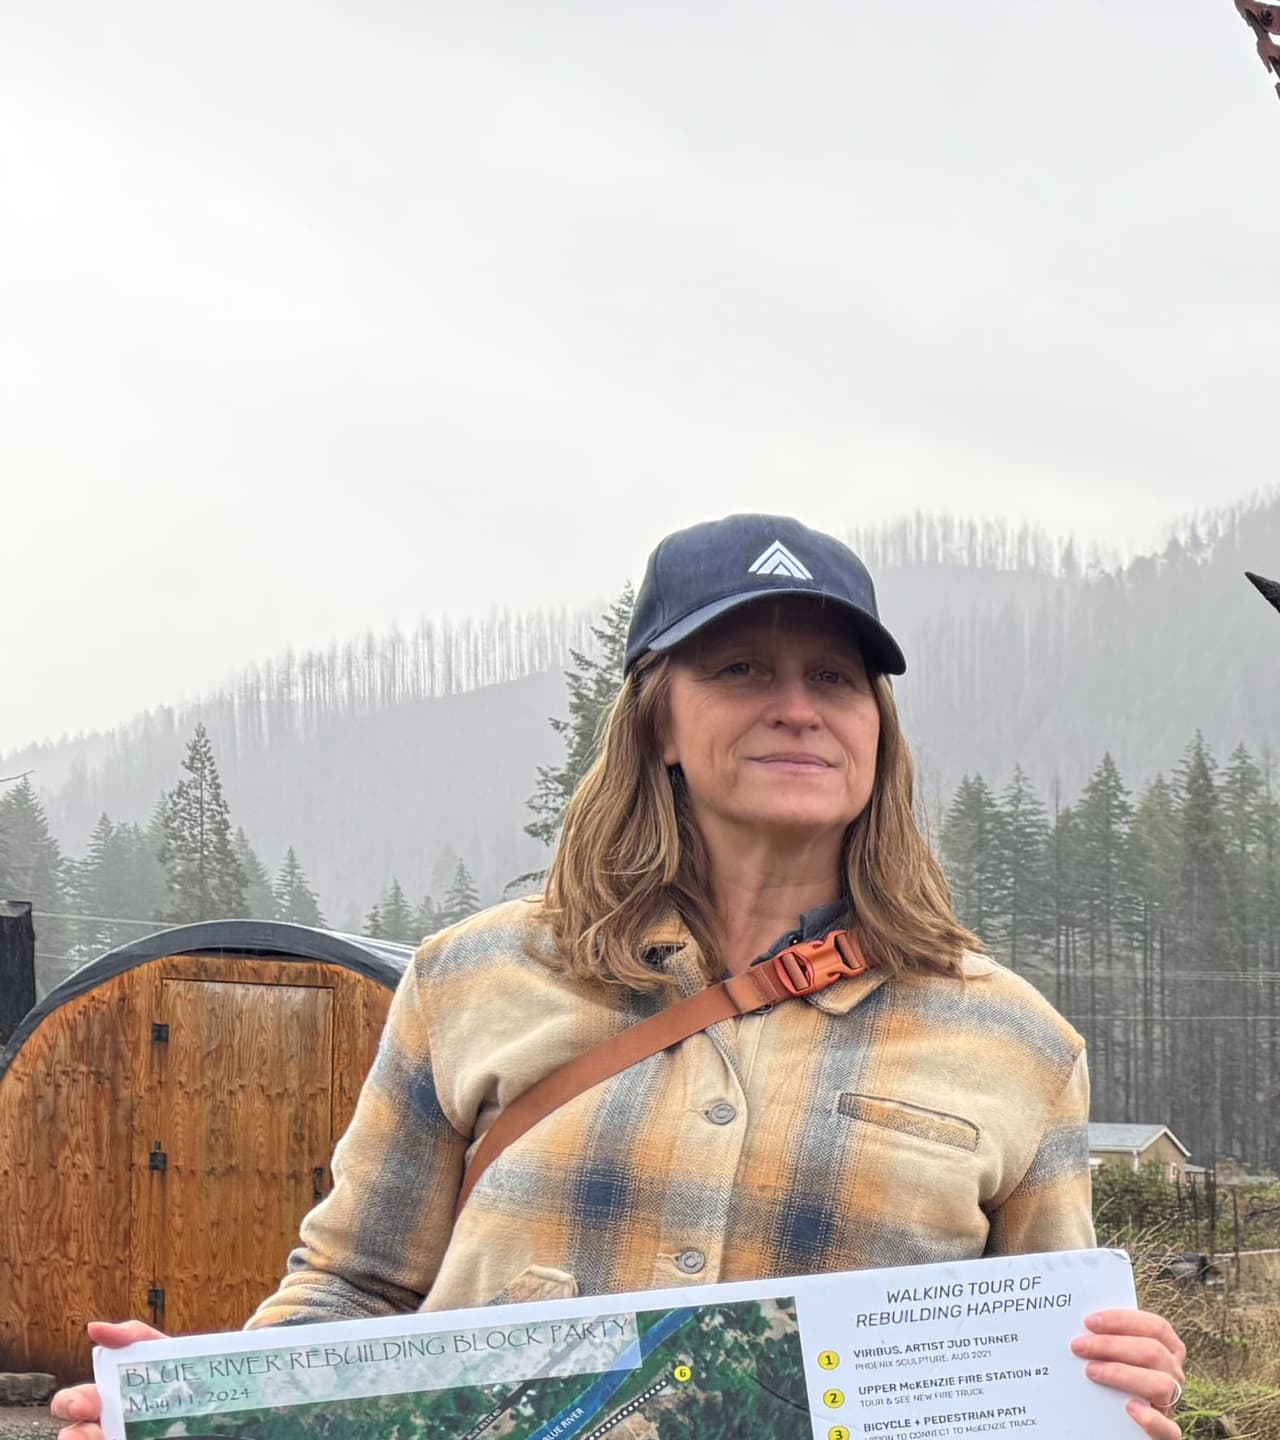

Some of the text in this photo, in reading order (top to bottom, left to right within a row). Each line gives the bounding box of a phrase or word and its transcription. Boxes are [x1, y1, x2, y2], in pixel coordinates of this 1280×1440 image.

[886, 1275, 1041, 1304] WALKING TOUR OF
[856, 1292, 1071, 1328] REBUILDING HAPPENING!
[126, 1317, 629, 1388] BLUE RIVER REBUILDING BLOCK PARTY
[904, 1340, 944, 1353] ARTIST
[946, 1338, 970, 1348] JUD
[972, 1333, 1018, 1346] TURNER
[858, 1383, 896, 1395] UPPER
[899, 1376, 955, 1391] McKENZIE
[957, 1373, 982, 1384] FIRE
[984, 1368, 1031, 1381] STATION
[128, 1394, 169, 1414] May
[205, 1386, 252, 1403] 2024
[863, 1418, 911, 1432] BICYCLE
[923, 1409, 994, 1425] PEDESTRIAN
[996, 1405, 1026, 1417] PATH
